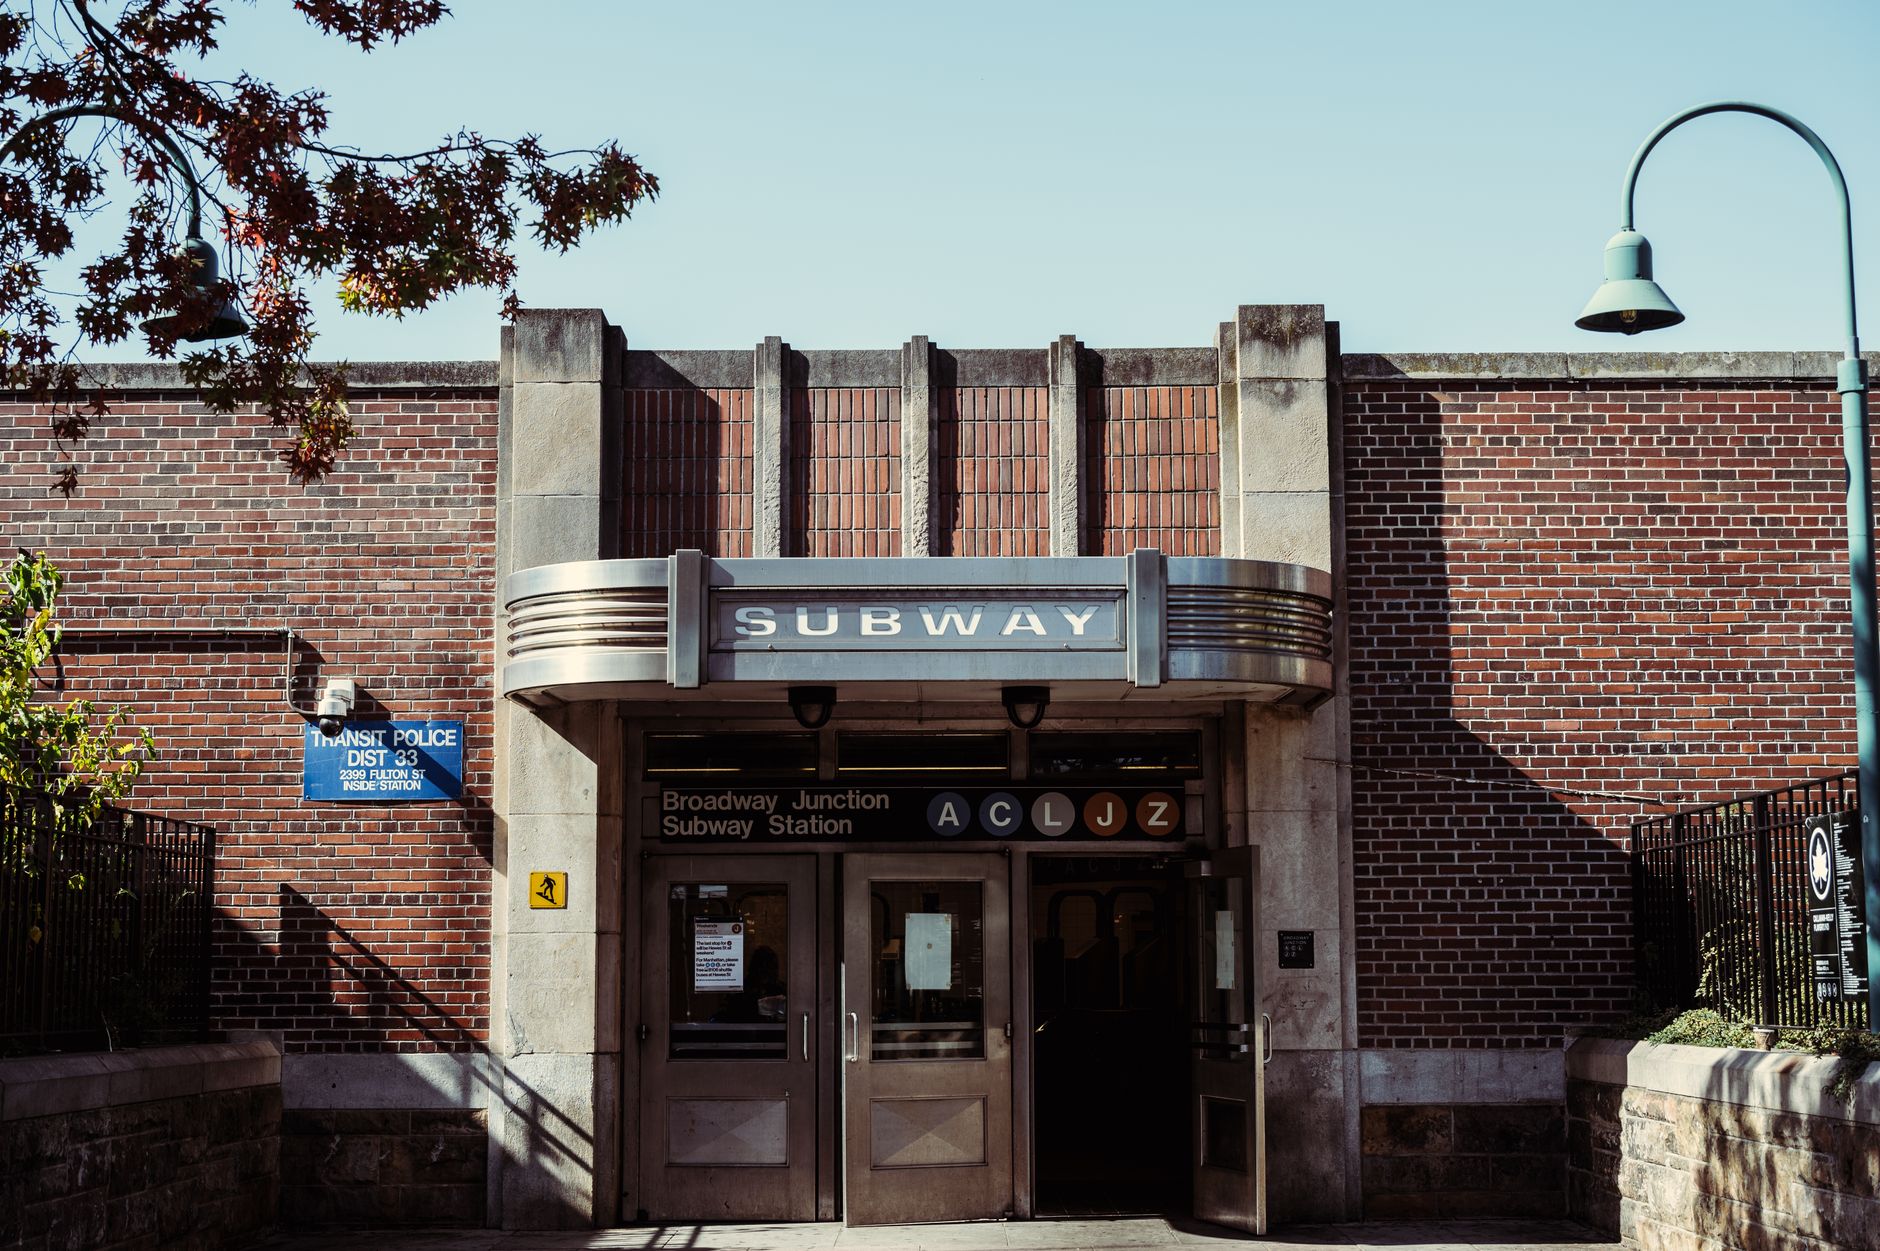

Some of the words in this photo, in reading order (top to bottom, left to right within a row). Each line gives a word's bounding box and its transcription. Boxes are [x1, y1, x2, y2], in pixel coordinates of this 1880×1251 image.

[734, 605, 1102, 636] SUBWAY
[311, 729, 386, 747] TRANSIT
[394, 729, 457, 747] POLICE
[347, 749, 388, 767] DIST
[395, 749, 418, 767] 33
[339, 769, 366, 780] 2399
[370, 769, 408, 780] FULTON
[412, 769, 426, 780] ST
[343, 780, 375, 791] INSIDE
[379, 780, 421, 791] STATION
[663, 790, 779, 814] Broadway
[792, 789, 890, 810] Junction
[937, 801, 960, 826] A
[989, 801, 1011, 827] C
[1044, 802, 1062, 826] L
[1096, 802, 1113, 827] J
[1147, 802, 1168, 826] Z
[663, 815, 754, 840] Subway
[769, 814, 852, 835] Station
